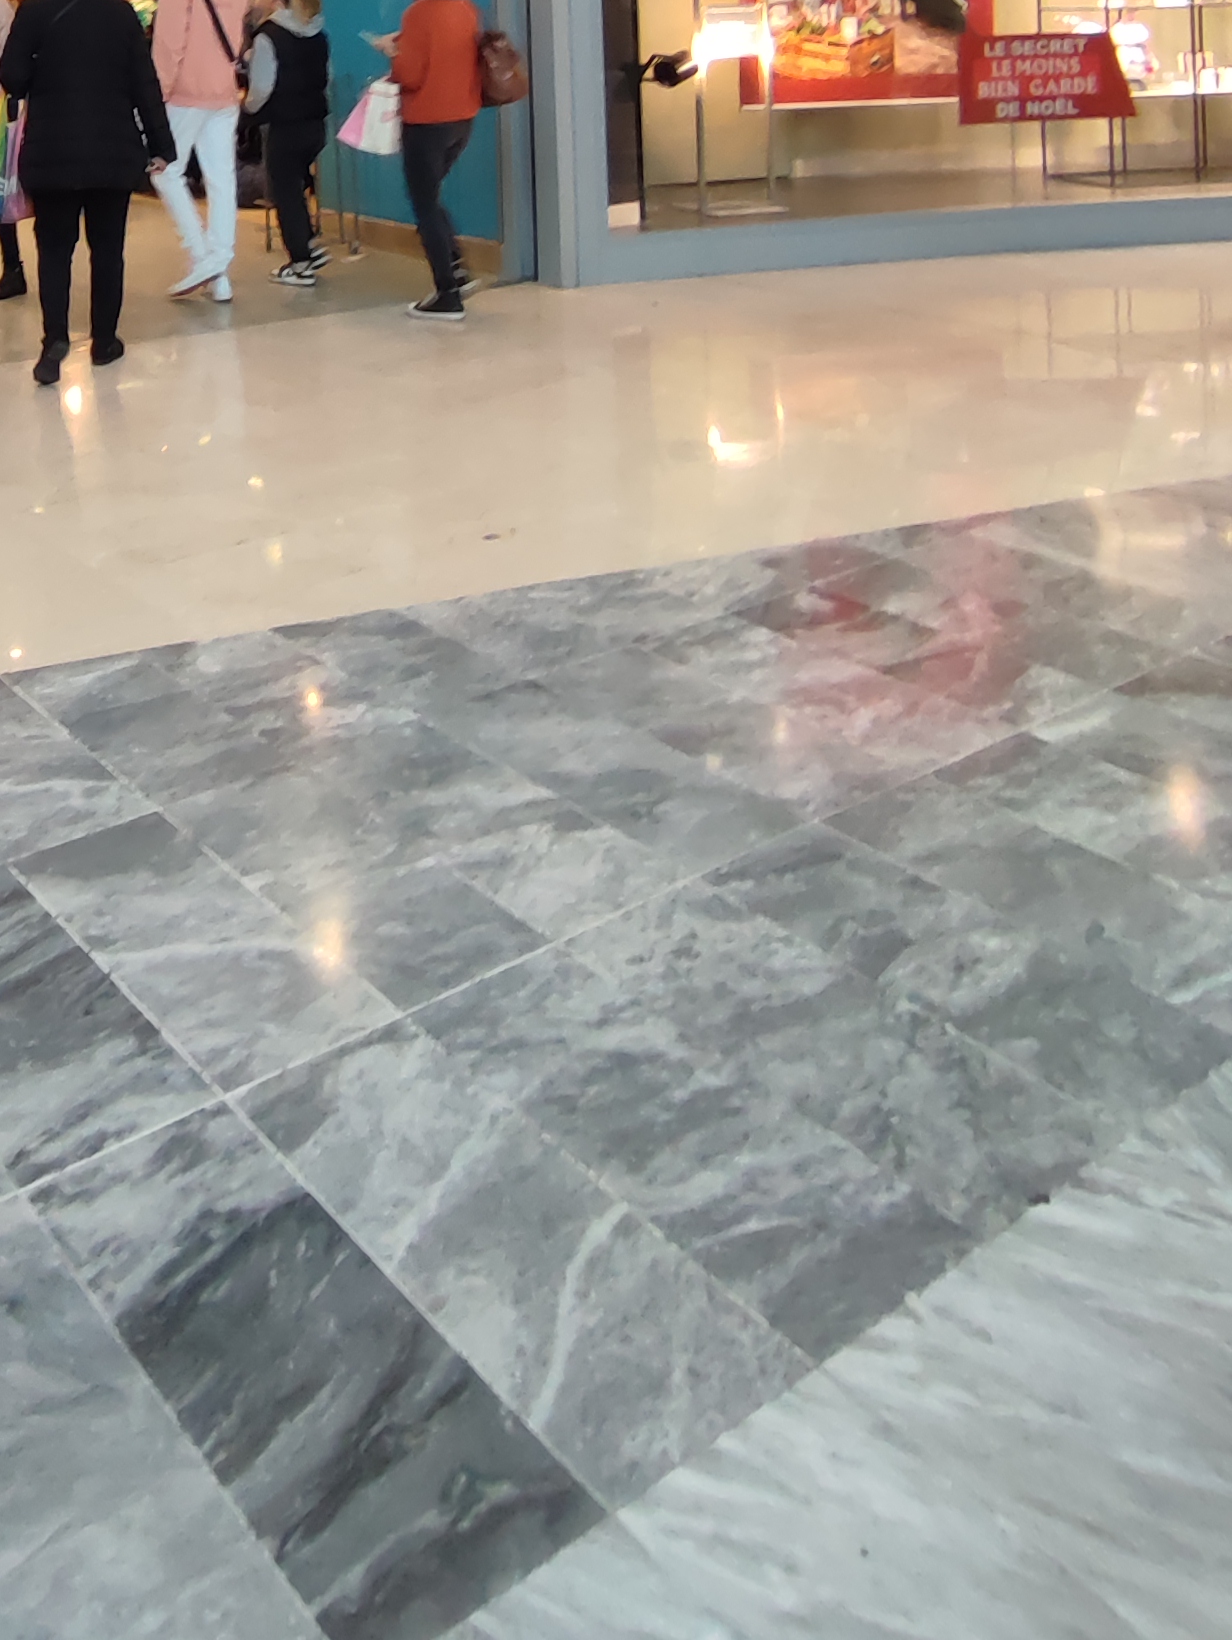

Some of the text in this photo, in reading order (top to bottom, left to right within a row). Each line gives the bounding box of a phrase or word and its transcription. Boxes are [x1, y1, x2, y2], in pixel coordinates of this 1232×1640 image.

[983, 37, 1088, 57] LE SECRET
[991, 56, 1081, 77] LE MOINS
[977, 79, 1020, 99] BIEN
[996, 101, 1020, 118] DE
